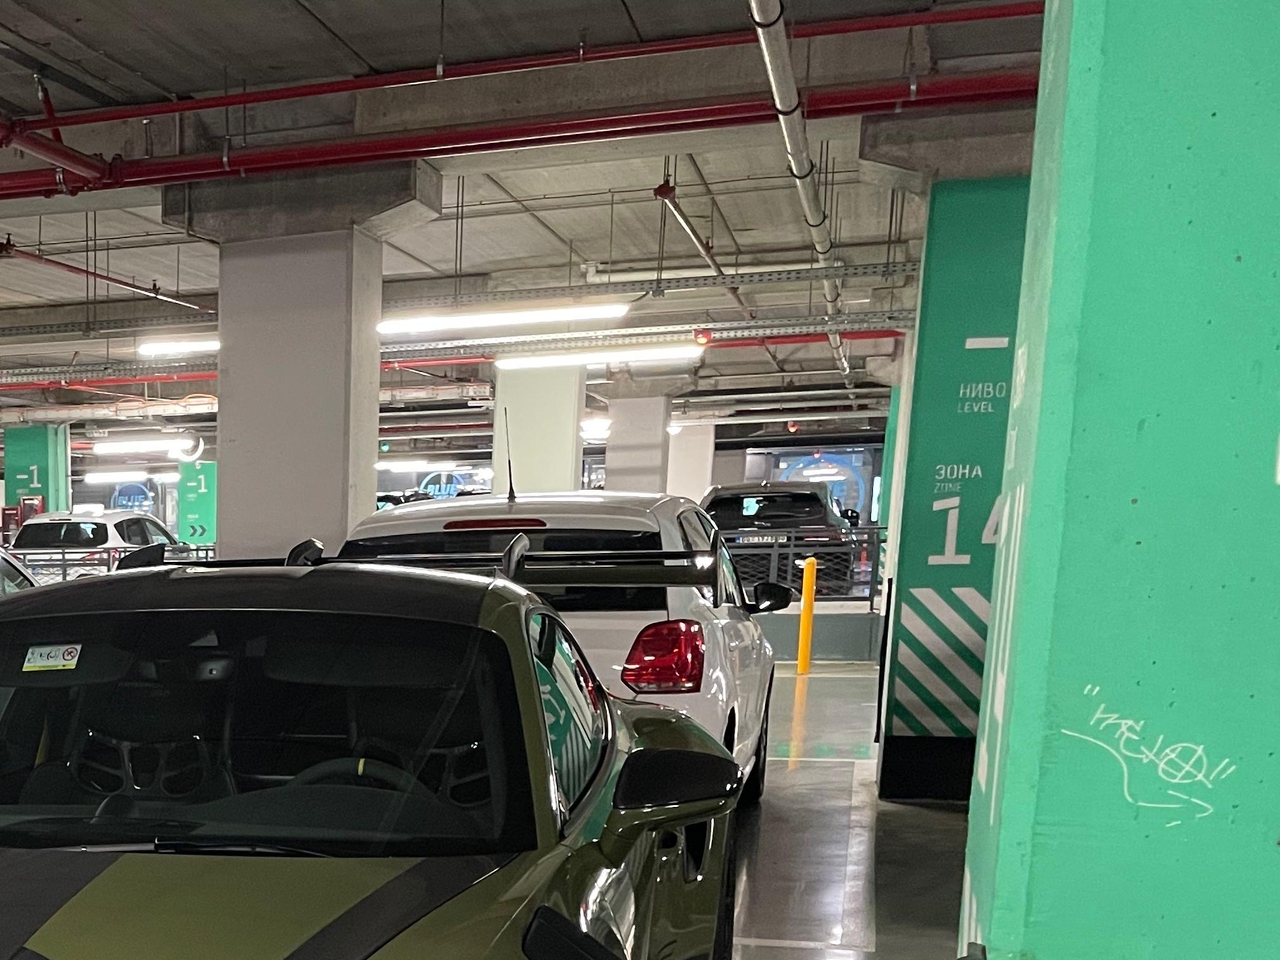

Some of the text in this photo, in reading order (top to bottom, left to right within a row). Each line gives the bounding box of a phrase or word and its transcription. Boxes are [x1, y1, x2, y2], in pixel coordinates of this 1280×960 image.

[959, 382, 1007, 399] НИВО
[957, 401, 995, 413] LEVEL
[16, 465, 42, 488] -1
[935, 464, 982, 480] ЗОНА
[186, 474, 208, 493] -1
[427, 484, 458, 496] BLUE
[934, 482, 963, 493] ZONE
